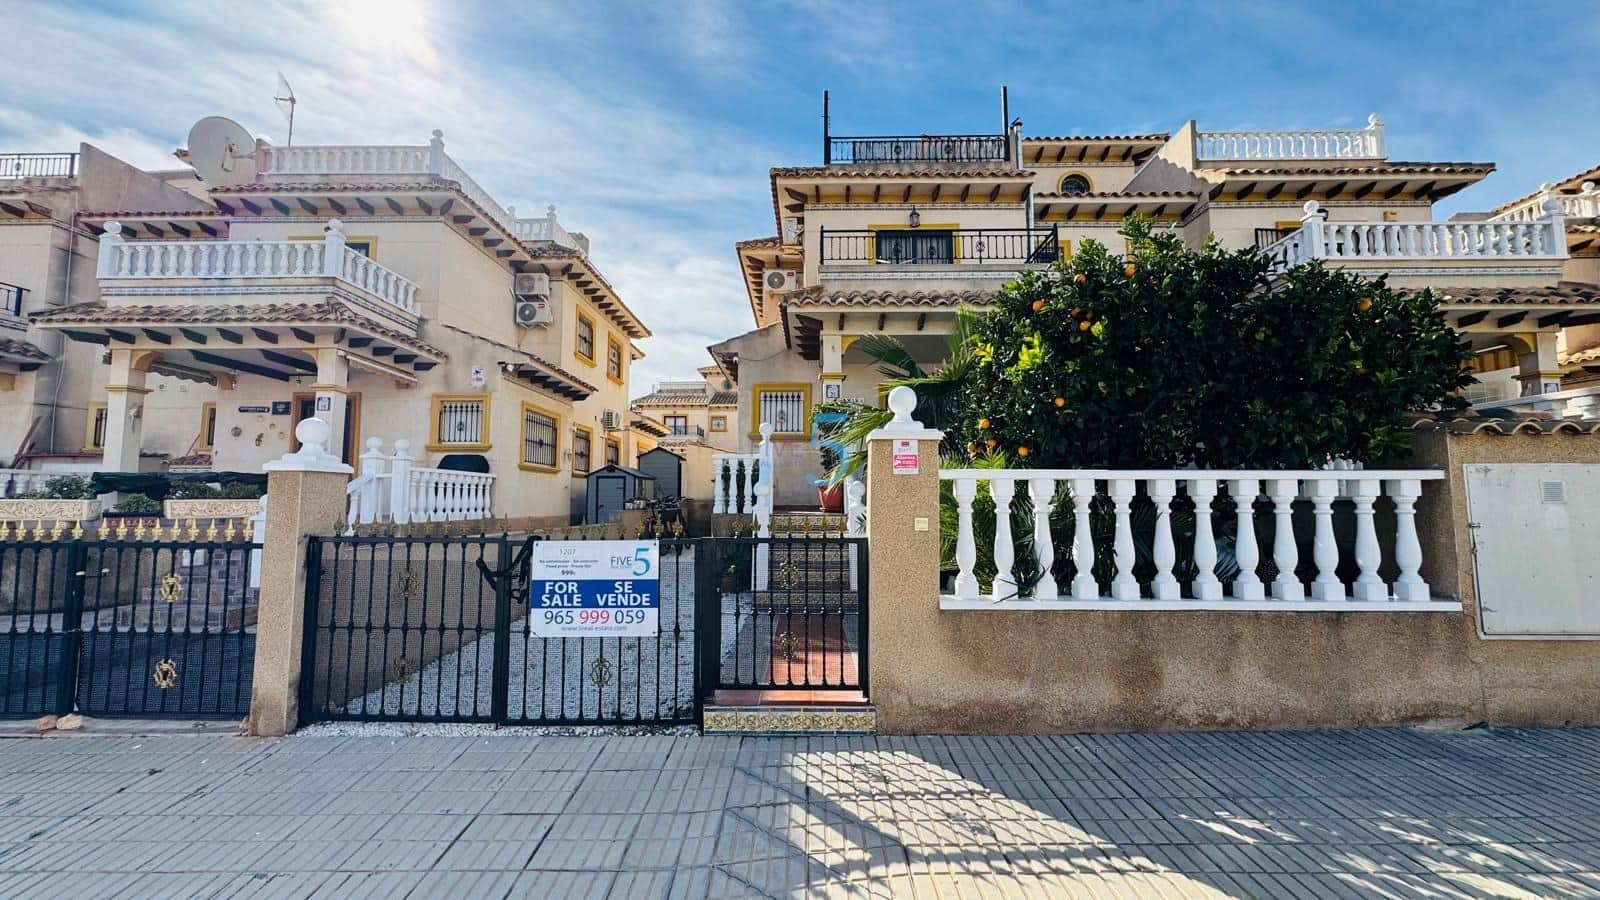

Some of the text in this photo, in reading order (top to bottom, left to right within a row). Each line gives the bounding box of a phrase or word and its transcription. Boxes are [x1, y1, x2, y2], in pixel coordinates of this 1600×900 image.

[560, 548, 577, 556] 1207
[610, 547, 651, 577] FIVE 5
[544, 581, 579, 594] FOR
[614, 581, 634, 593] SE
[541, 594, 583, 607] SALE
[596, 594, 651, 606] VENDE
[543, 609, 646, 625] 965 999 059
